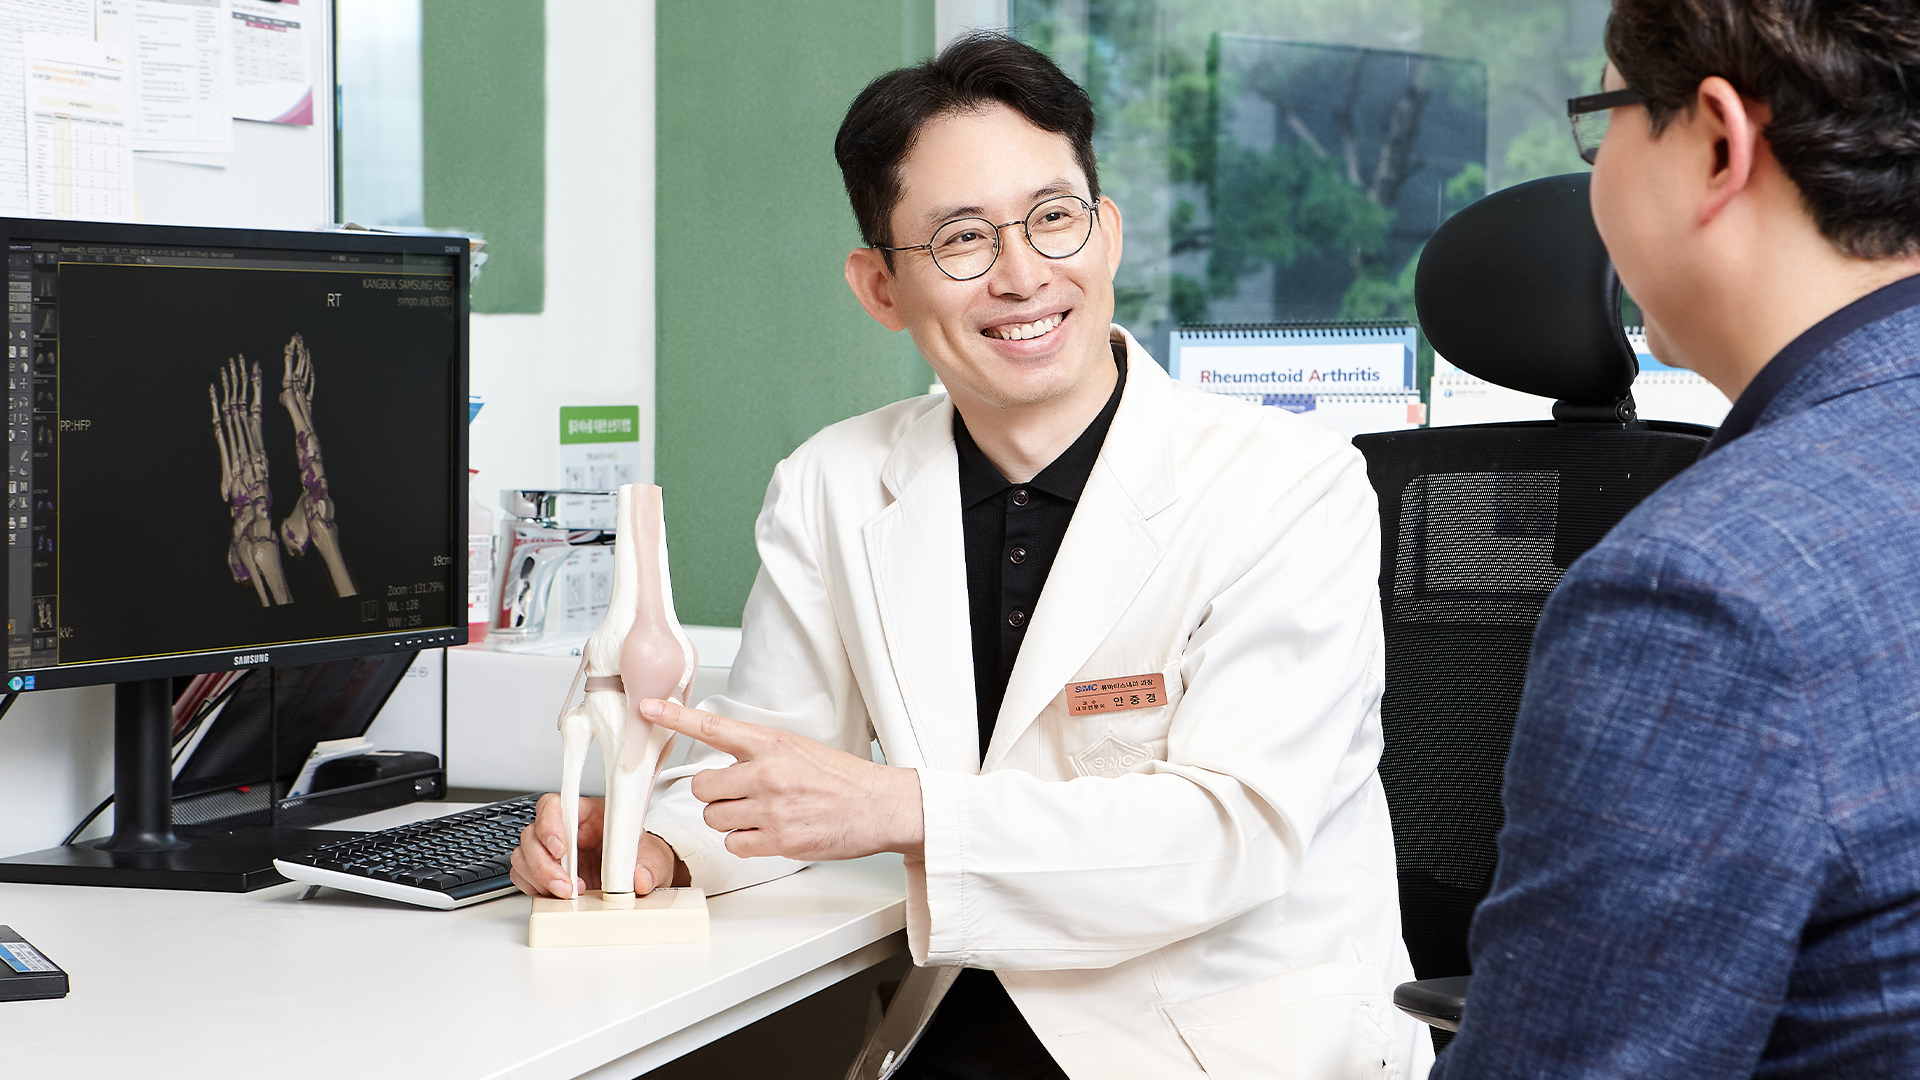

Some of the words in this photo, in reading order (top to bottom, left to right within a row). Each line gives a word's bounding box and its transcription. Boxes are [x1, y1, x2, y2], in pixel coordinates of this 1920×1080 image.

[363, 279, 397, 290] KANGBUK
[398, 279, 432, 291] SAMSUNG
[327, 293, 342, 307] RT
[1201, 368, 1303, 384] Rheumatoid
[1309, 367, 1380, 383] Arthritis
[60, 420, 91, 431] PP:HFP
[387, 585, 407, 596] Zoom
[414, 581, 444, 594] 131.79%
[387, 601, 399, 612] WL
[406, 599, 418, 610] 128
[408, 615, 421, 626] 256
[233, 652, 269, 666] SAMSUNG
[1075, 683, 1098, 694] SMC
[1101, 681, 1139, 691] 류마티스내과
